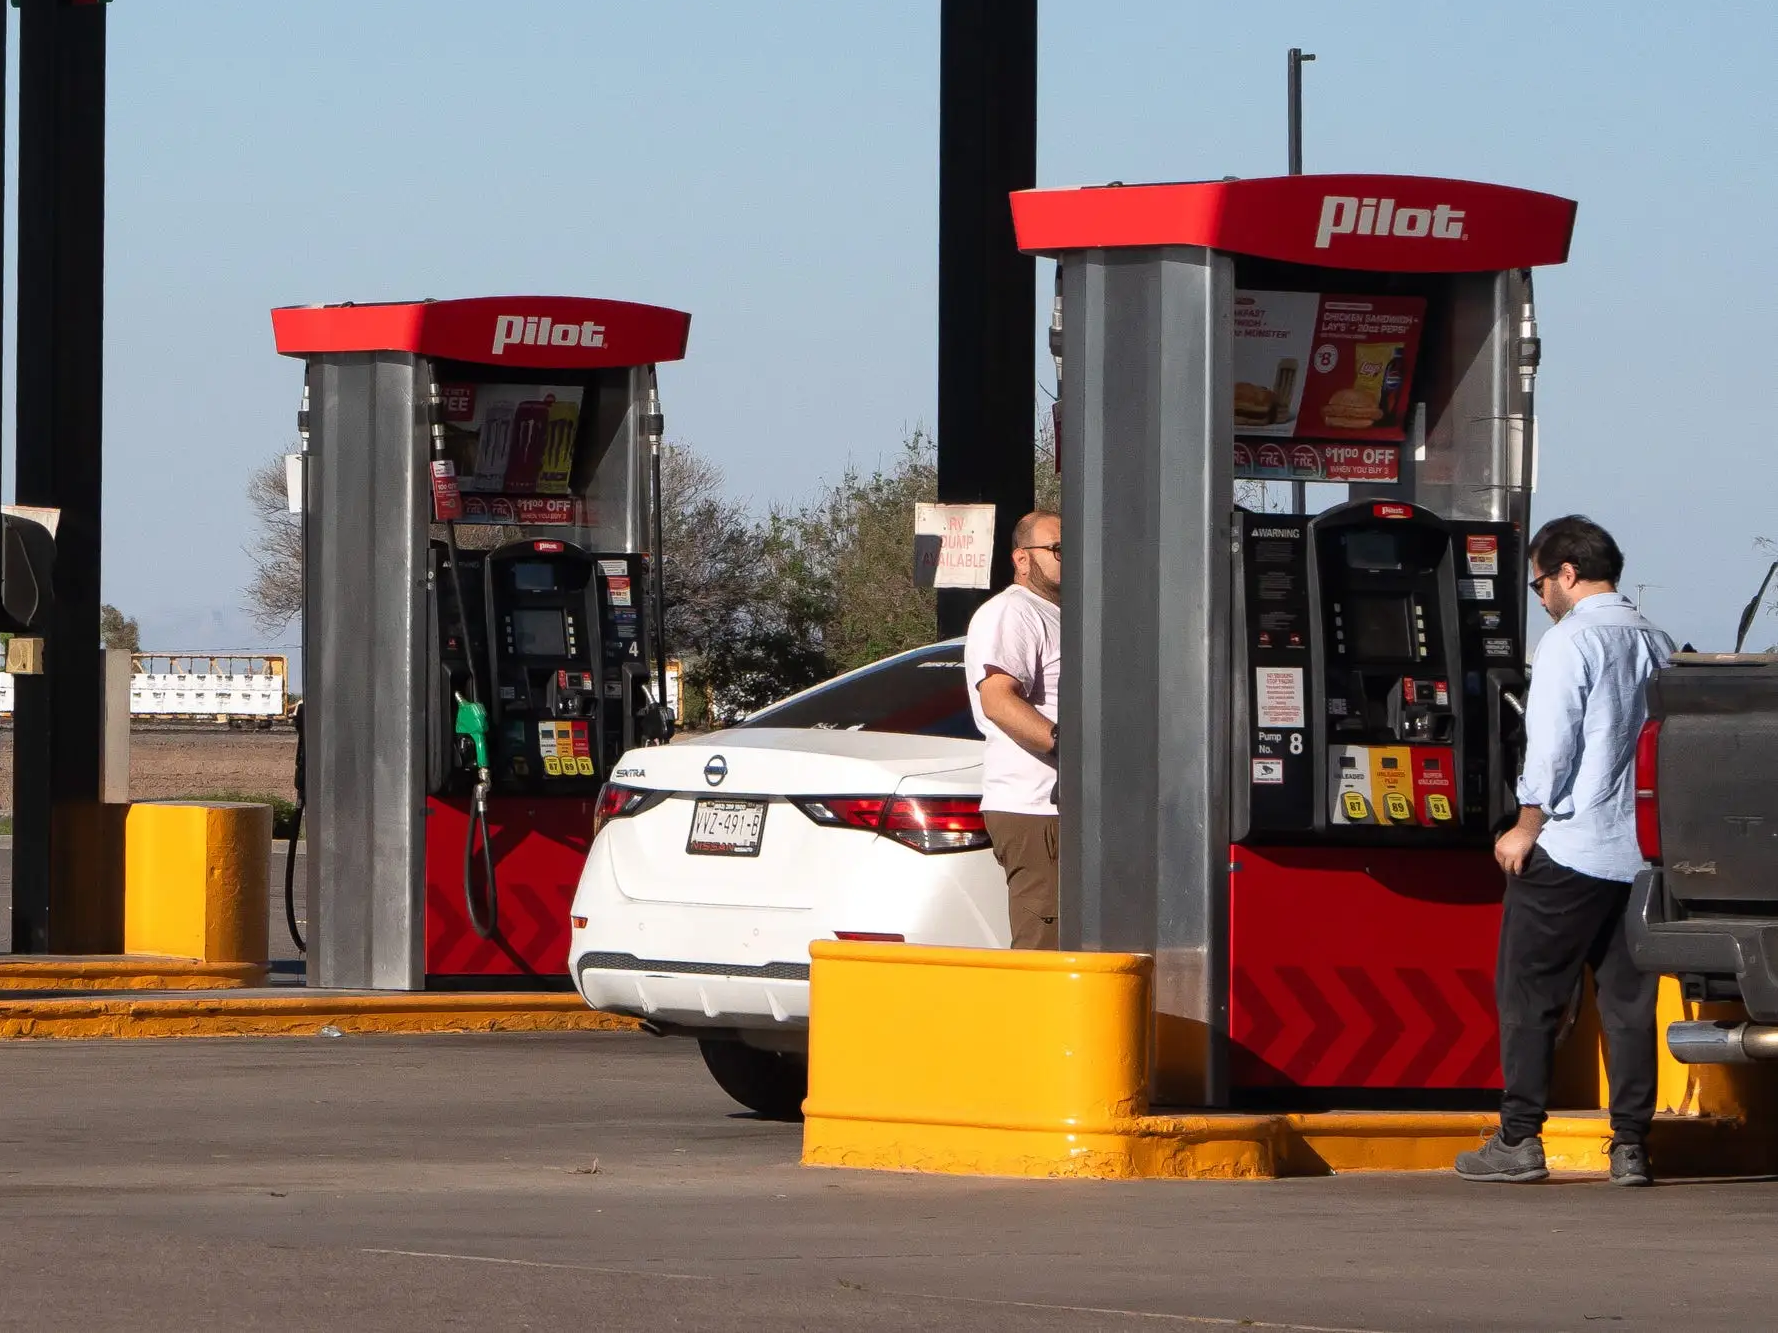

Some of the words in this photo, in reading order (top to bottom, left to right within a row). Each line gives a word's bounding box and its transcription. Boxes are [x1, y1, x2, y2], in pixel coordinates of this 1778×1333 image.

[1362, 448, 1395, 465] OFF
[1330, 465, 1351, 473] WHEN
[1352, 466, 1367, 474] YOU
[546, 500, 571, 512] OFF
[948, 516, 965, 531] RV
[1259, 528, 1300, 538] WARNING
[940, 534, 974, 550] DUMP
[923, 552, 986, 568] AVAILABLE
[628, 641, 639, 657] 4
[1258, 732, 1282, 743] Pump
[1289, 733, 1303, 754] 8
[1258, 745, 1273, 754] No.
[1349, 801, 1361, 812] 87
[1391, 802, 1405, 813] 89
[1433, 803, 1447, 814] 91
